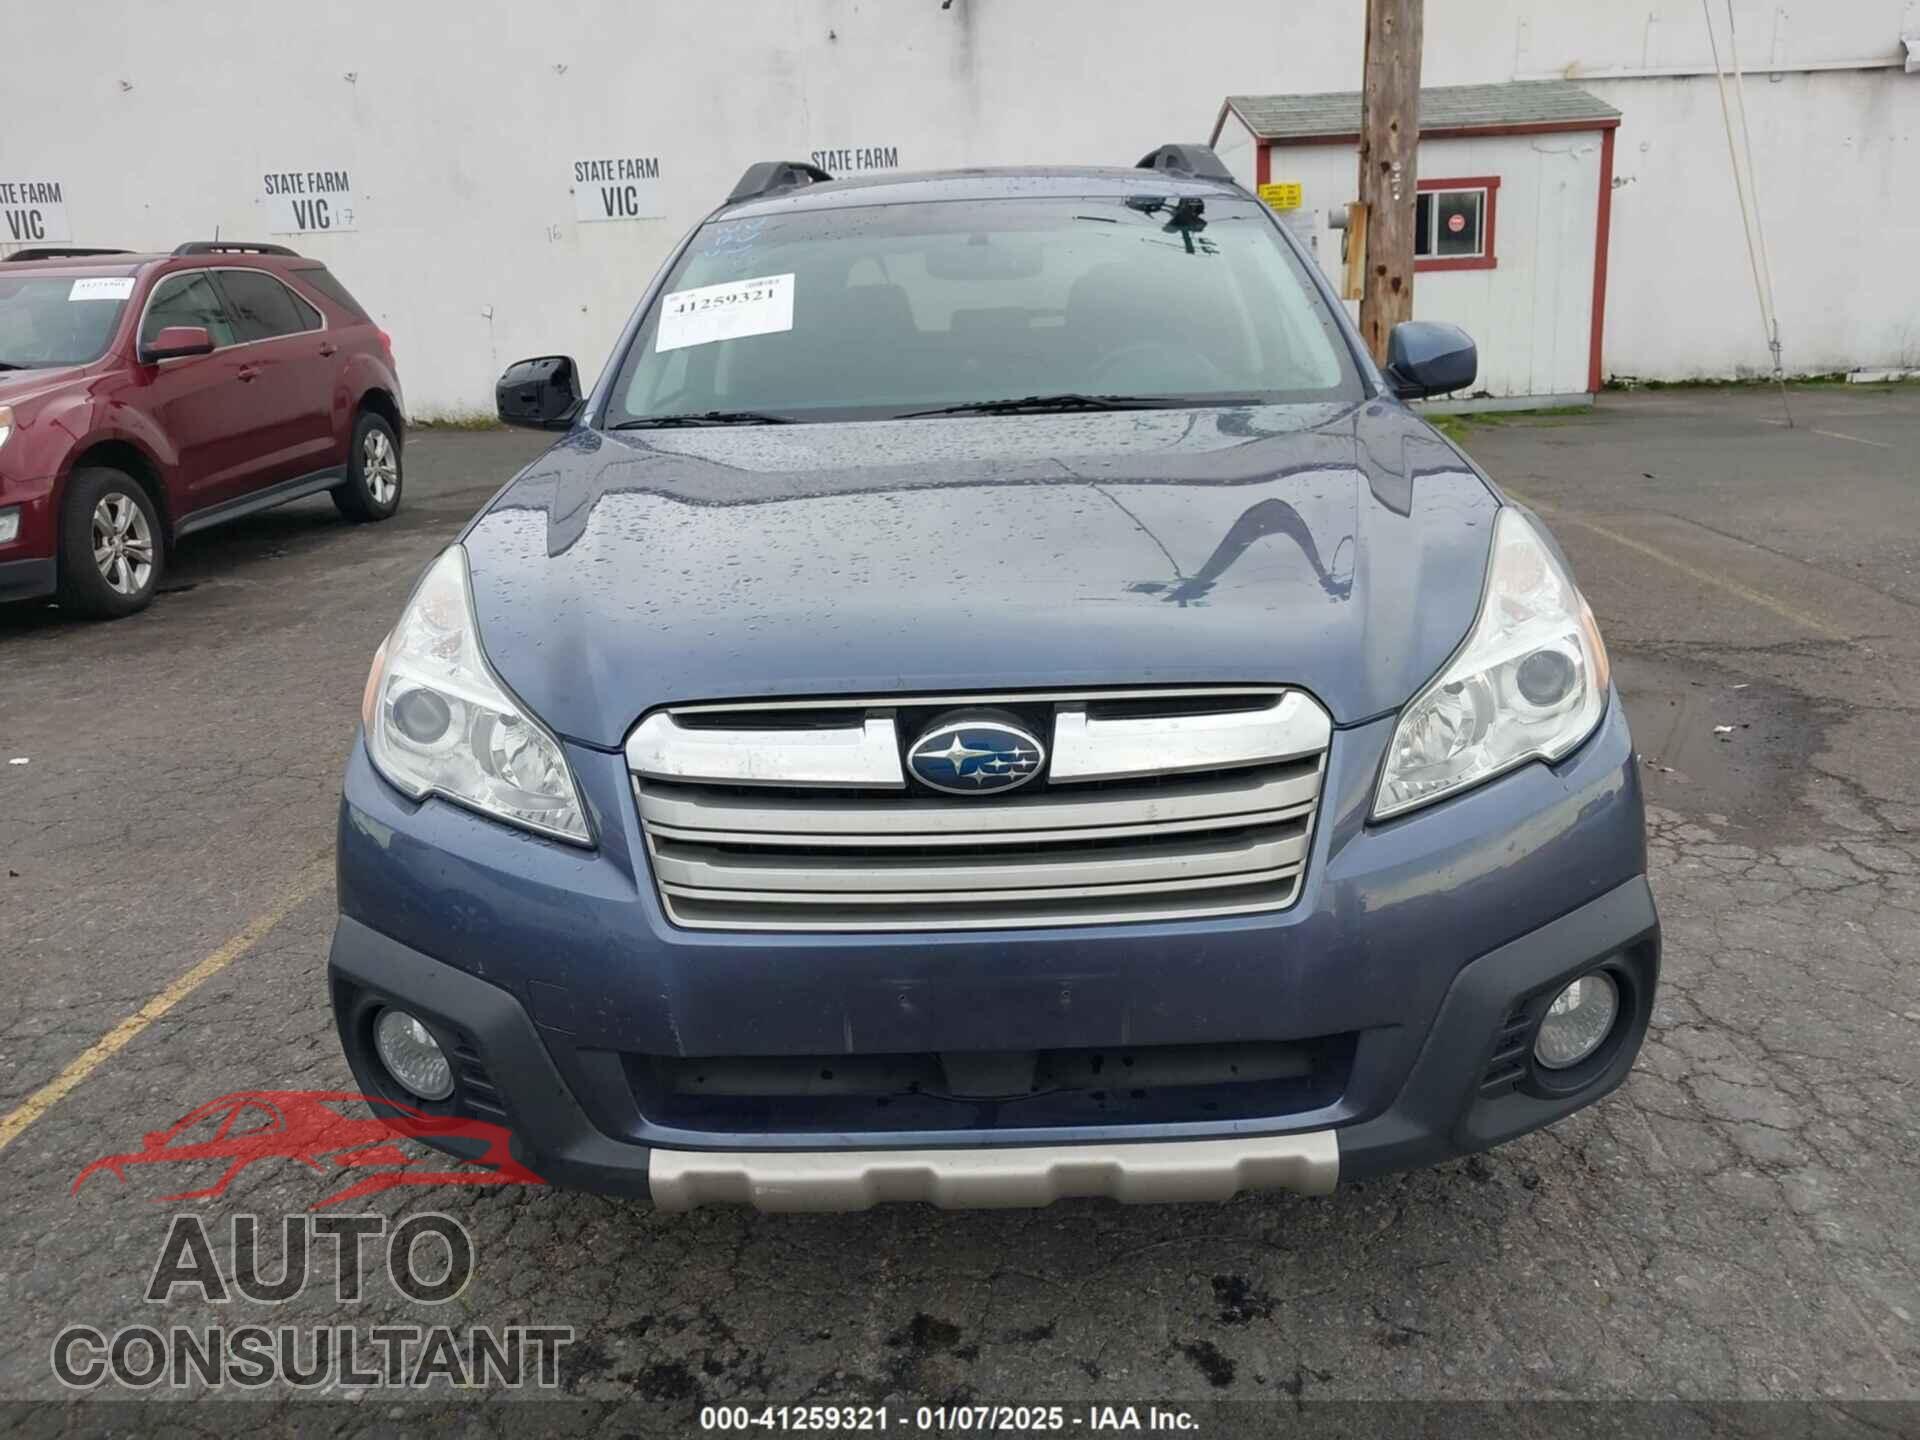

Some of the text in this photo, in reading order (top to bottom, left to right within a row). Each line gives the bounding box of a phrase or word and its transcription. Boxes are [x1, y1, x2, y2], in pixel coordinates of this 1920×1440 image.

[575, 157, 660, 182] STATE FARM
[811, 147, 898, 171] STATE FARM
[19, 182, 62, 203] FARM
[264, 171, 350, 195] STATE FARM
[601, 186, 639, 217] VIC
[6, 209, 45, 240] VIC
[292, 199, 330, 230] VIC
